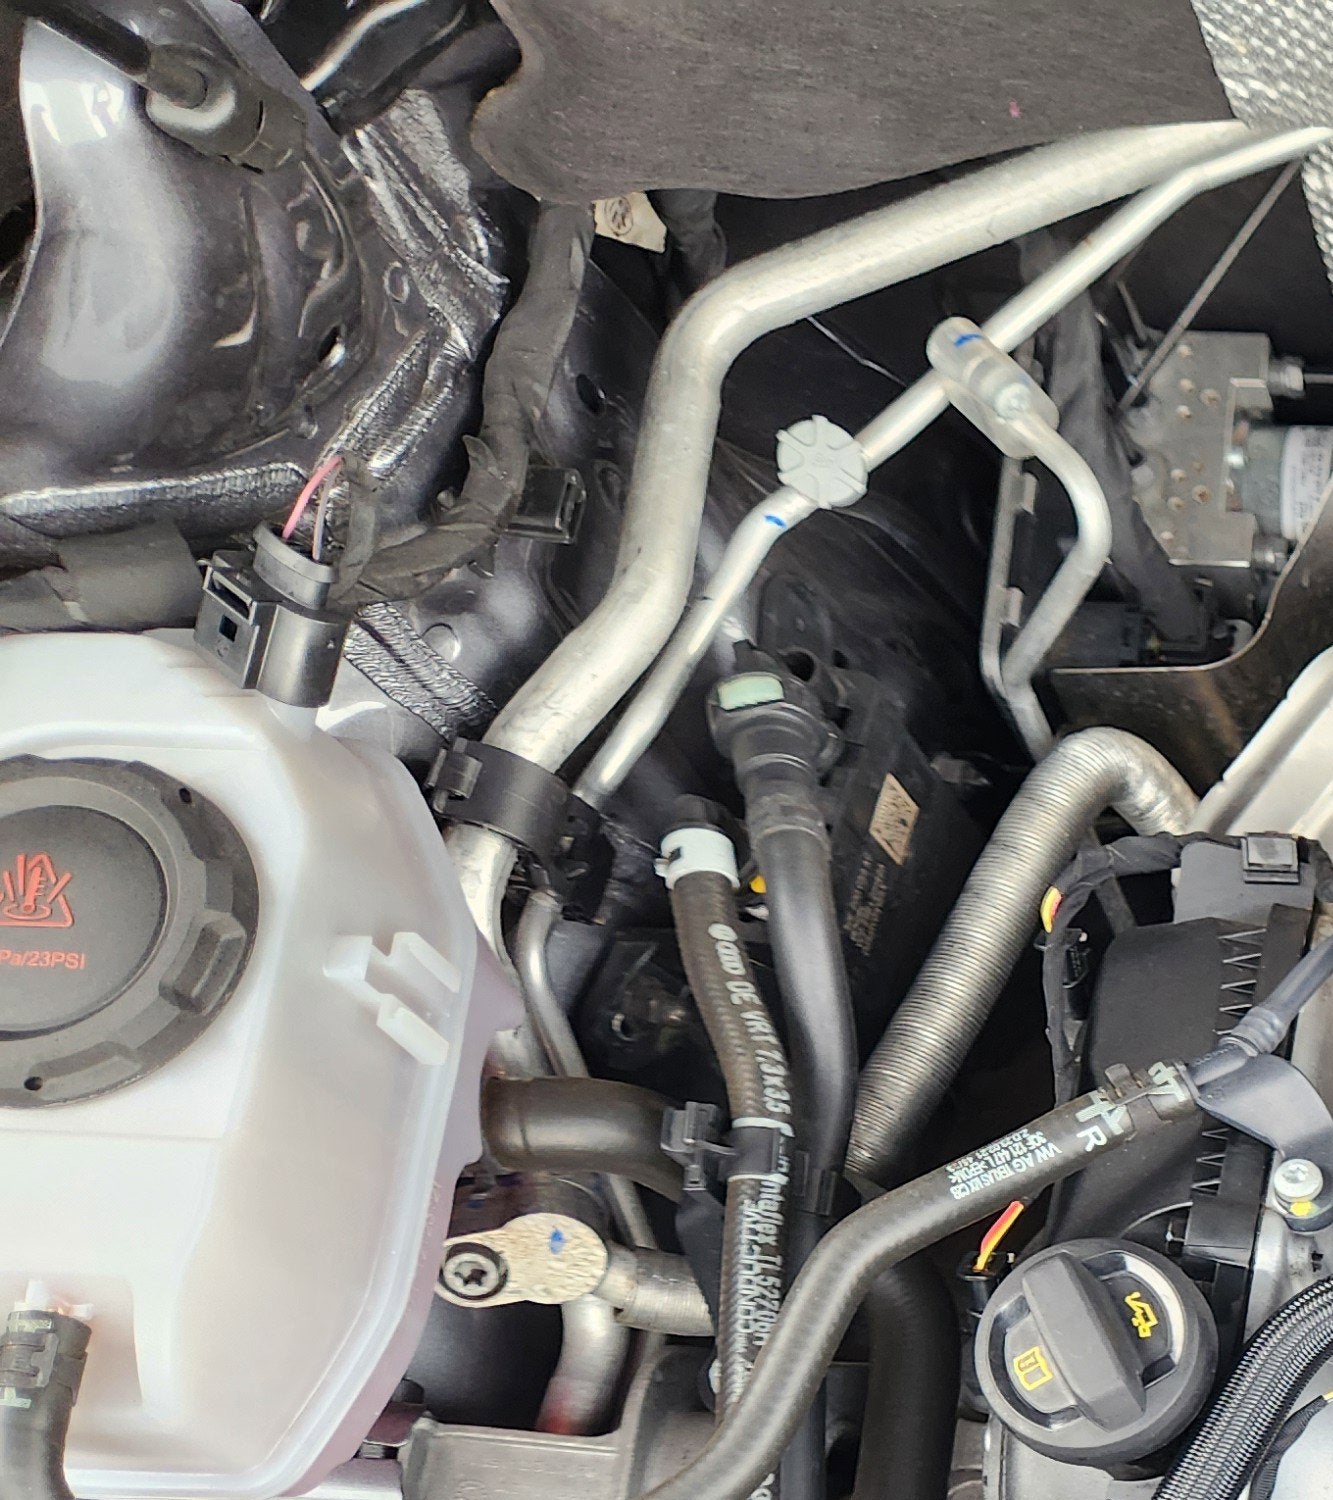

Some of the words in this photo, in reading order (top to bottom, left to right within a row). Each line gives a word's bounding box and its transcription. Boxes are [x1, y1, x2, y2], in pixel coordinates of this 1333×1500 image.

[1076, 1125, 1107, 1152] R
[1034, 1140, 1060, 1162] VW
[1012, 1153, 1034, 1173] AG
